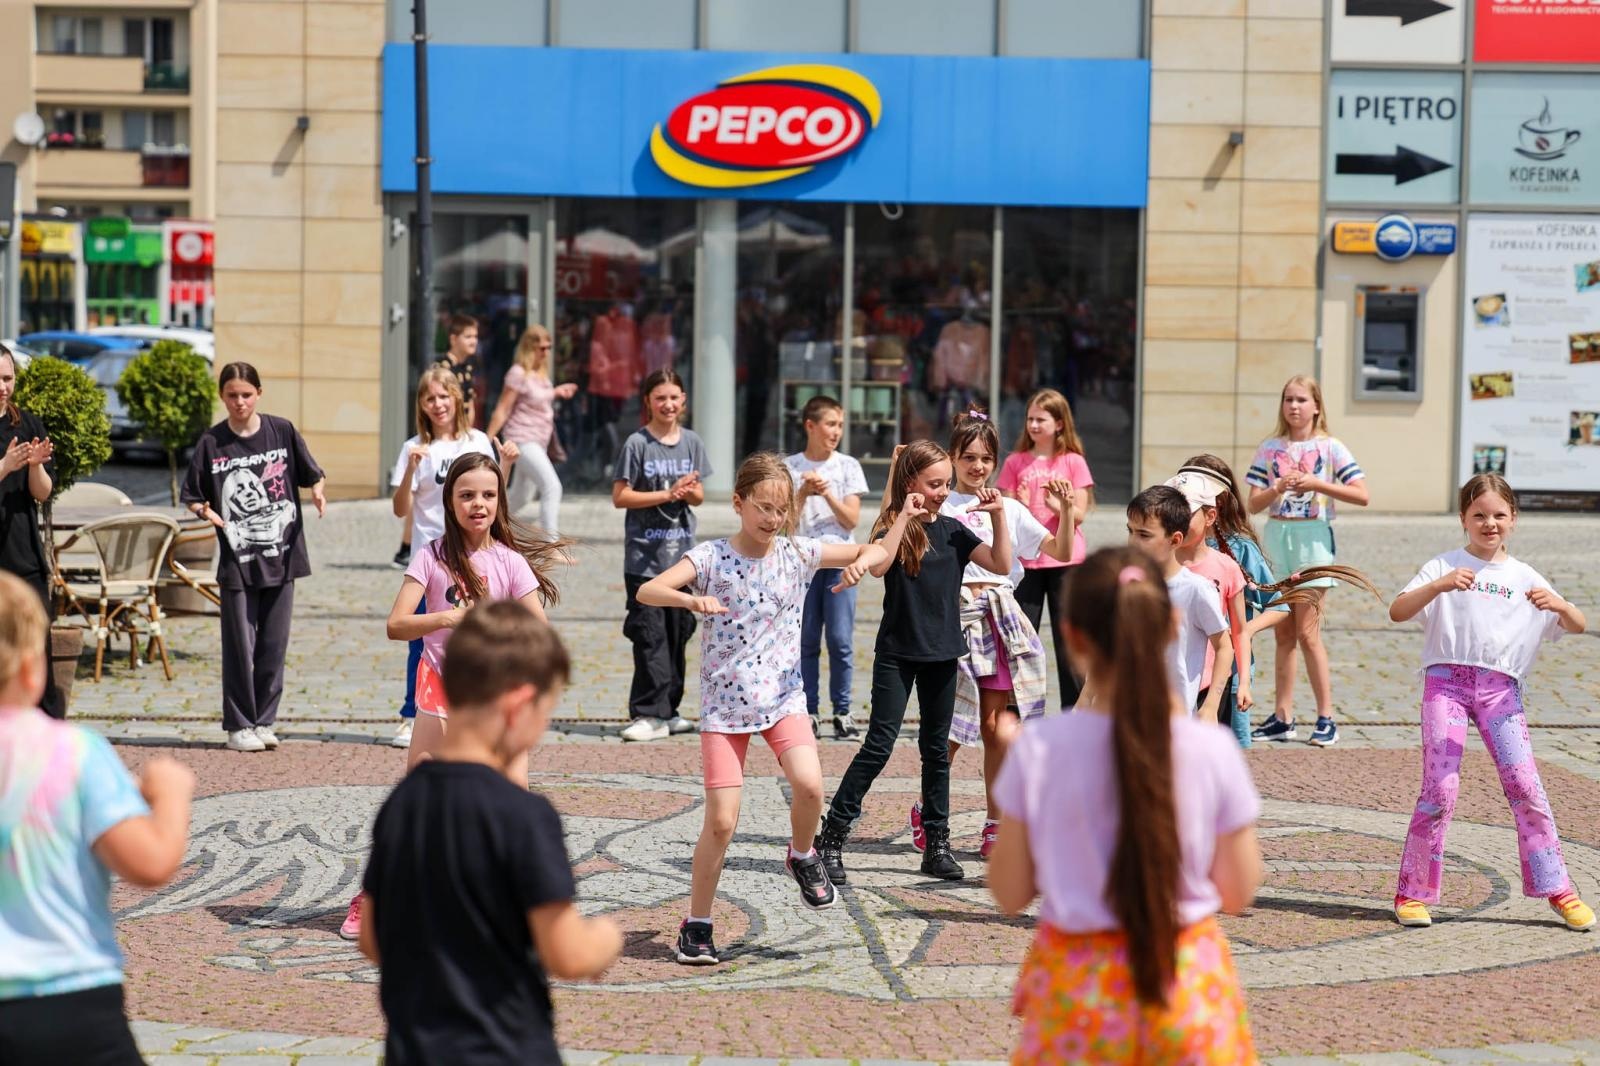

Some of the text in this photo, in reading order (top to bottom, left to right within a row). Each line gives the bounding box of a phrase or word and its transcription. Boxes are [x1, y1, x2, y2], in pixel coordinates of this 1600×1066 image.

[1338, 96, 1457, 125] I PIĘTRO
[687, 105, 846, 147] PEPCO
[1509, 166, 1580, 182] KOFEINKA
[1536, 223, 1597, 236] KOFEINKA
[1457, 582, 1514, 599] OLIDAY
